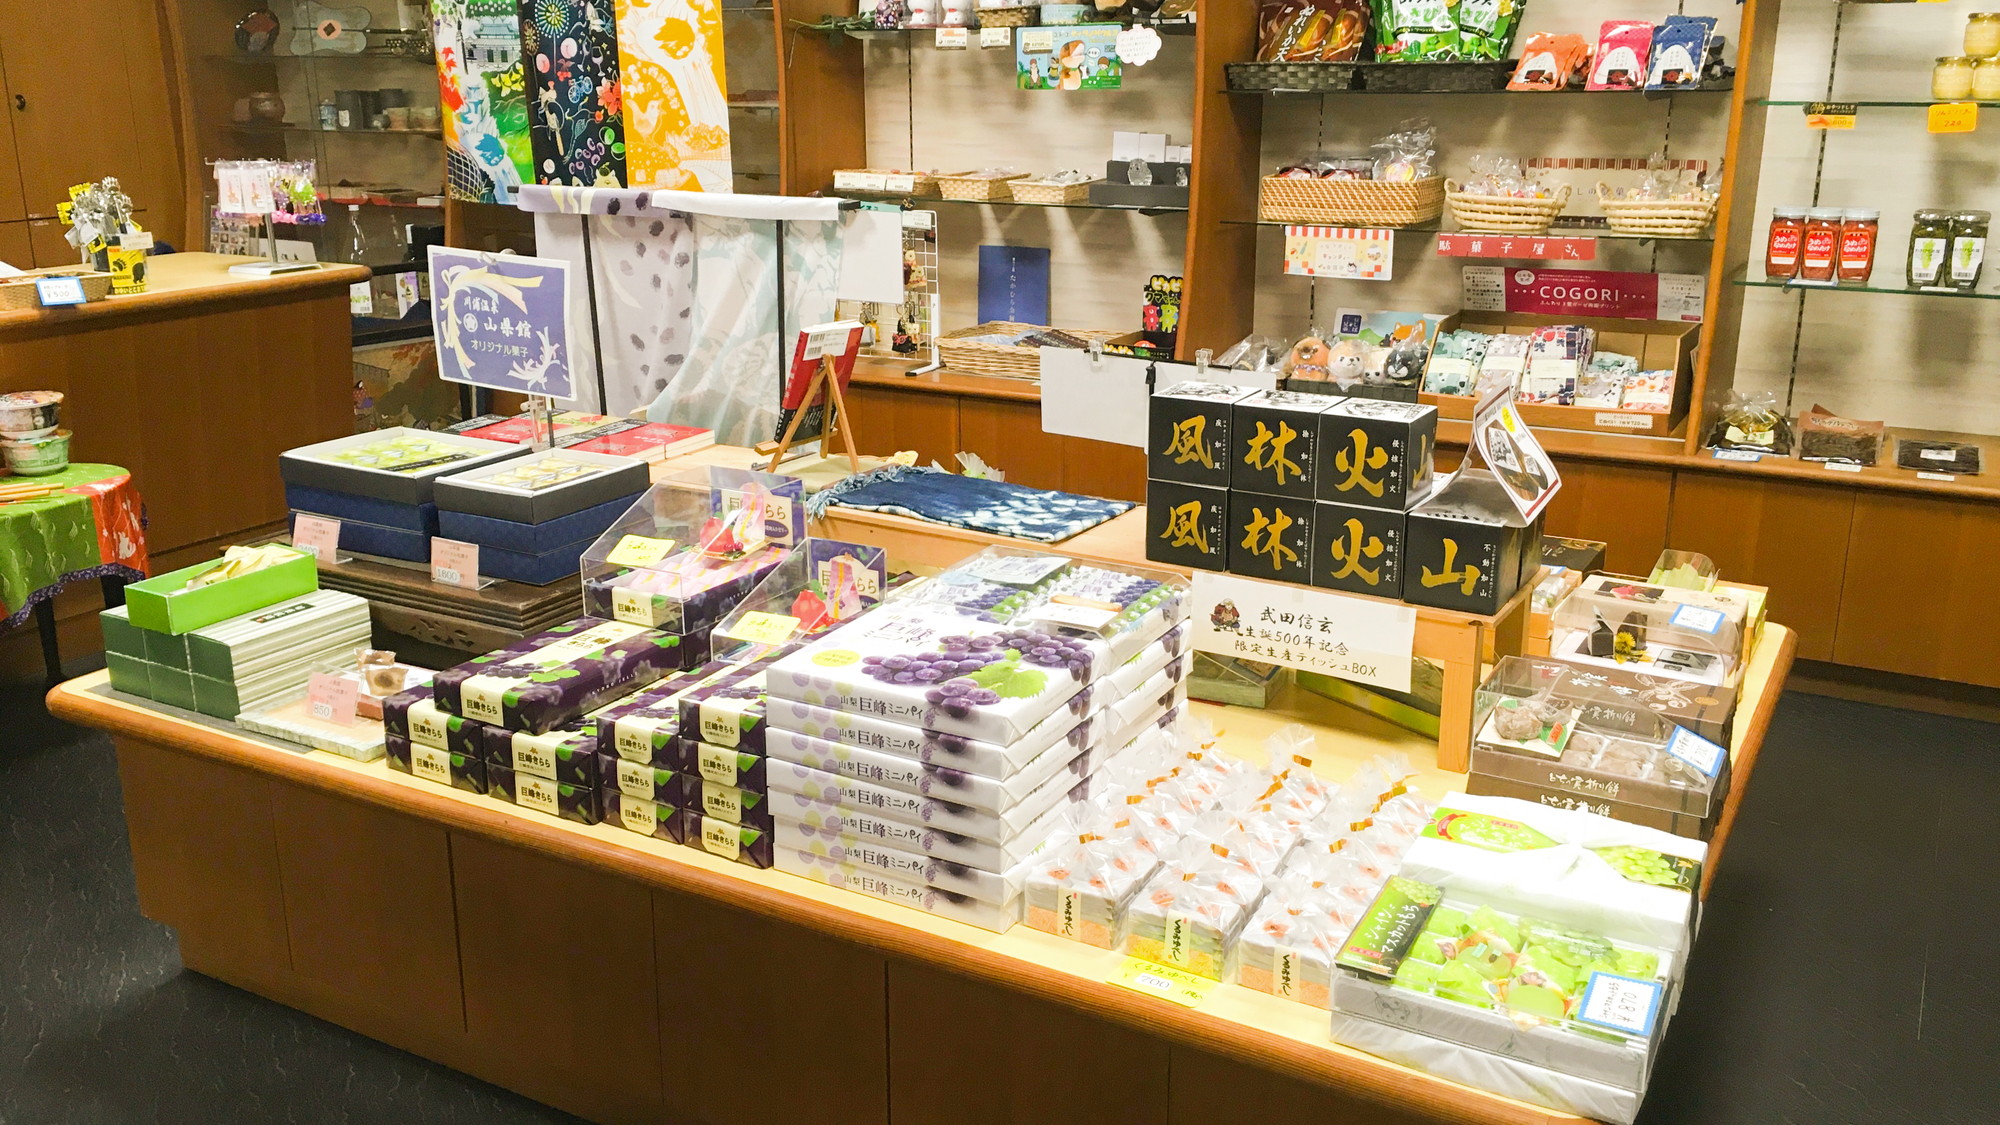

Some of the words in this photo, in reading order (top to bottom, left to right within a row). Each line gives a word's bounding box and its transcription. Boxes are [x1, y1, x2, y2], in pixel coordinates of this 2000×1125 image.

[1438, 240, 1579, 257] 駄菓子屋さん
[464, 296, 499, 314] 川浦温泉
[1540, 286, 1619, 302] COGORI
[483, 316, 532, 339] 山県館
[471, 339, 528, 357] オリジナル菓子
[1162, 414, 1214, 470] 風
[1243, 420, 1302, 486] 林
[1334, 427, 1389, 498] 火
[1159, 500, 1209, 554] 風
[1241, 507, 1298, 571] 林
[1330, 517, 1385, 586] 火
[1421, 537, 1481, 596] 山
[1479, 543, 1492, 597] 不動如山
[1260, 606, 1334, 635] 武田信玄
[1245, 625, 1350, 656] 生誕500年記念
[1234, 640, 1377, 678] 限定生産ティッシュBOX
[313, 703, 330, 717] 850
[466, 699, 498, 715] 巨峰きらら
[840, 695, 857, 708] 山梨
[859, 696, 923, 720] 巨峰ミニパイ
[413, 722, 443, 739] 巨峰きらら
[705, 721, 735, 735] 巨峰きらら
[838, 727, 857, 741] 山梨
[857, 729, 920, 754] 巨峰ミニパイ
[416, 757, 446, 774] 巨峰きらら
[517, 751, 551, 768] 巨峰きらら
[702, 759, 732, 773] 巨峰きらら
[621, 773, 650, 788] 巨峰きらら
[837, 760, 855, 772] 山梨
[856, 762, 919, 786] 巨峰ミニパイ
[521, 786, 553, 803] 巨峰きらら
[707, 796, 737, 811] 巨峰きらら
[838, 786, 856, 798] 山梨
[857, 789, 920, 814] 巨峰ミニパイ
[840, 816, 857, 828] 山梨
[858, 818, 922, 843] 巨峰ミニパイ
[844, 847, 861, 858] 山梨
[862, 850, 924, 875] 巨峰ミニパイ
[843, 874, 861, 886] 山梨
[861, 878, 923, 903] 巨峰ミニパイ
[1380, 904, 1419, 953] マスカットもち
[1134, 961, 1199, 985] くるみゆべし
[1141, 974, 1170, 989] 700
